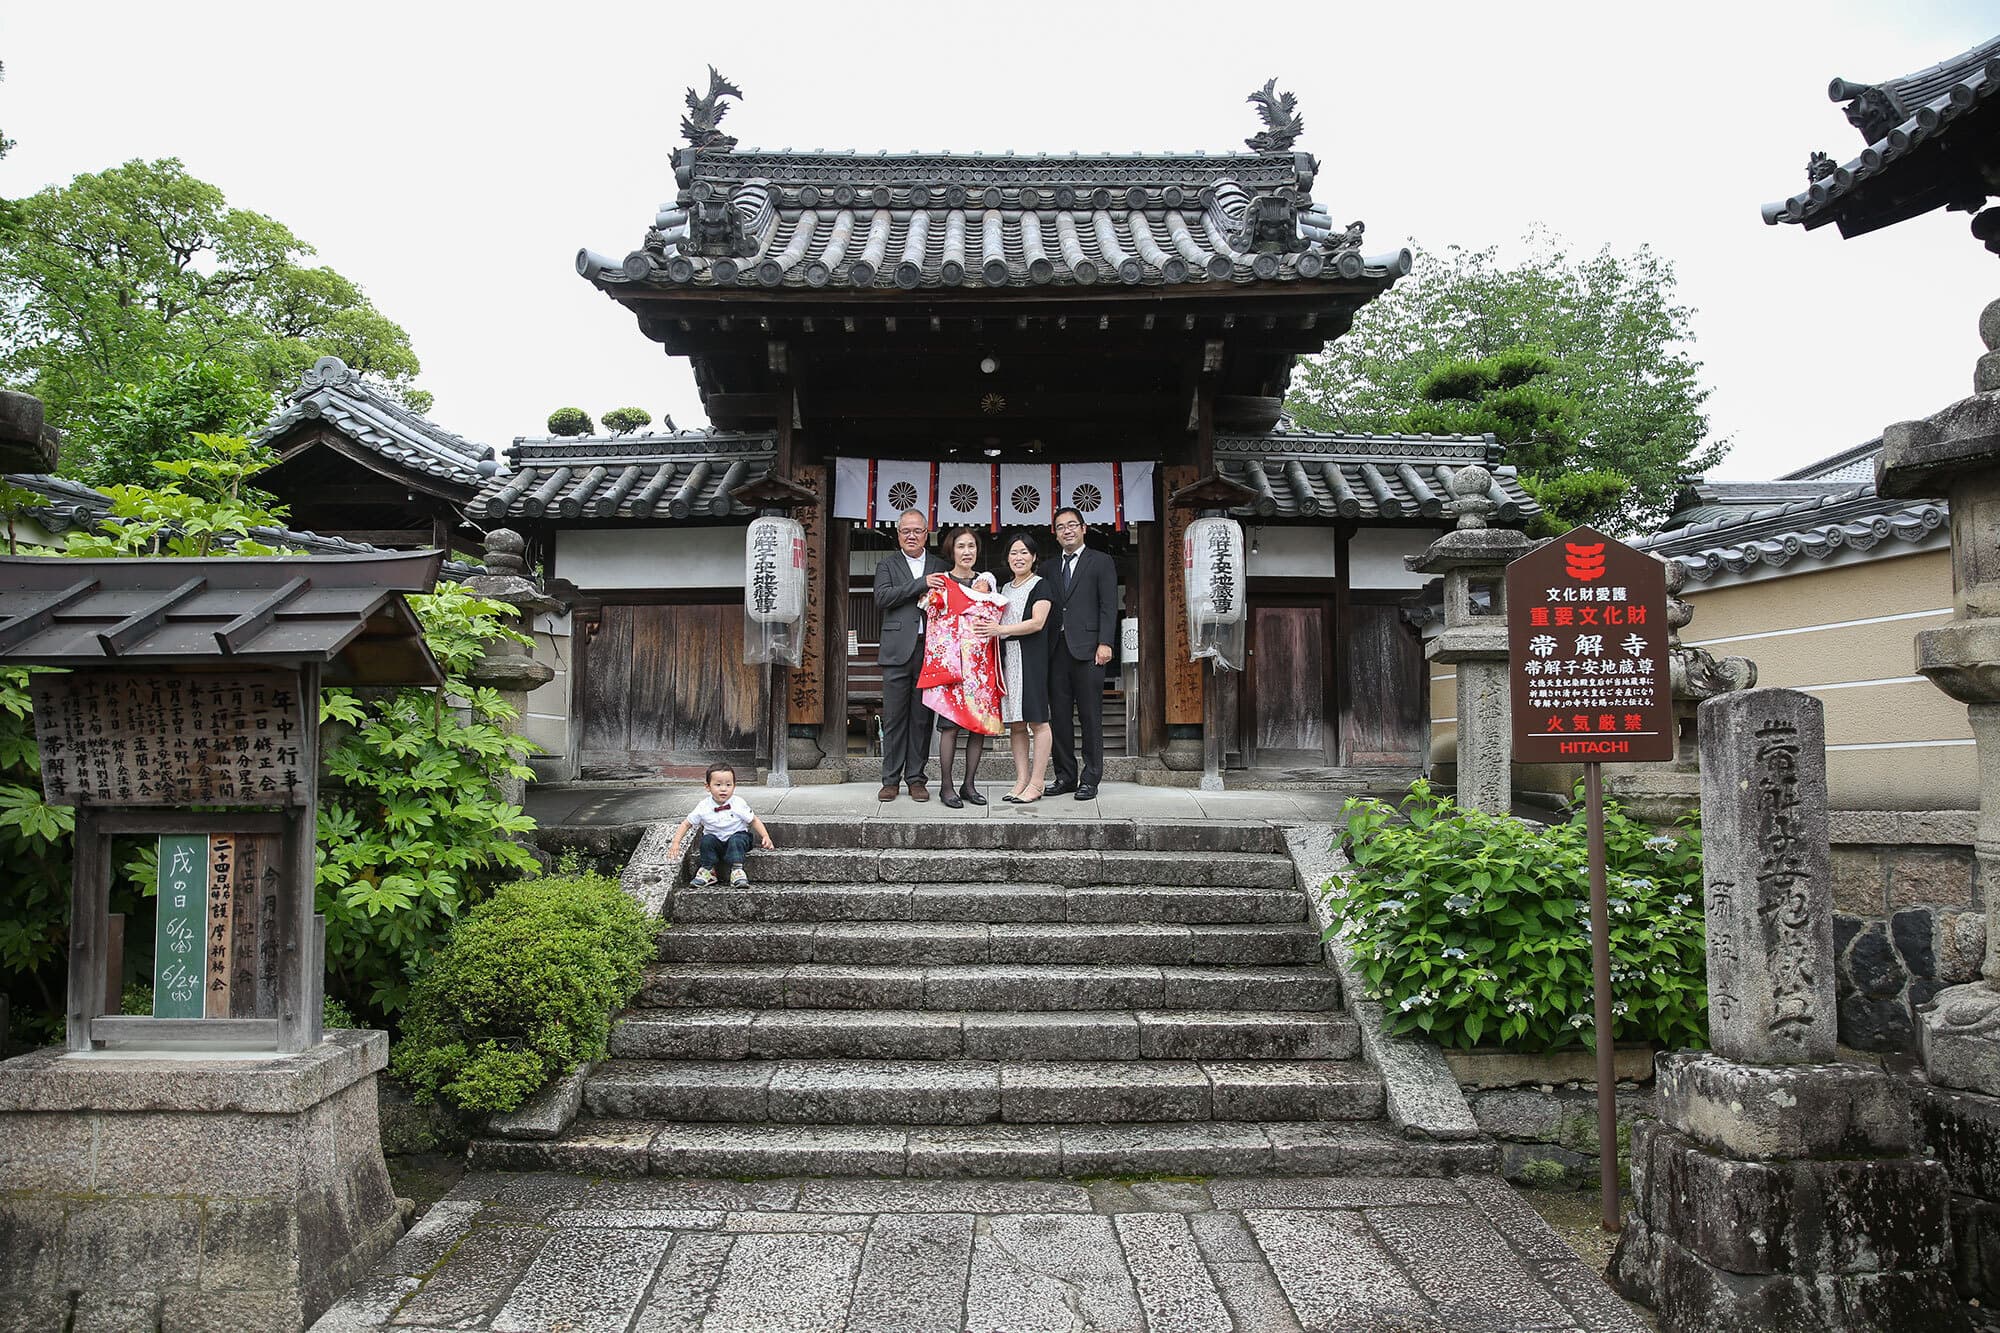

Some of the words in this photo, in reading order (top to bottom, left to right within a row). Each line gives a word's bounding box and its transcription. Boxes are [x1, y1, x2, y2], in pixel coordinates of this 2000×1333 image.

[1207, 524, 1235, 614] 帯解子安地蔵尊
[1546, 587, 1628, 602] 文化財愛護
[1530, 605, 1647, 627] 重要文化財
[1528, 632, 1649, 659] 帯解寺
[1524, 658, 1655, 677] 帯解子安地蔵尊
[1547, 713, 1642, 732] 火気厳禁
[271, 689, 303, 792] 年中行事
[1560, 741, 1629, 754] HITACHI
[169, 844, 196, 908] 戌の日
[166, 917, 195, 940] 6/12
[161, 963, 200, 989] 6/24
